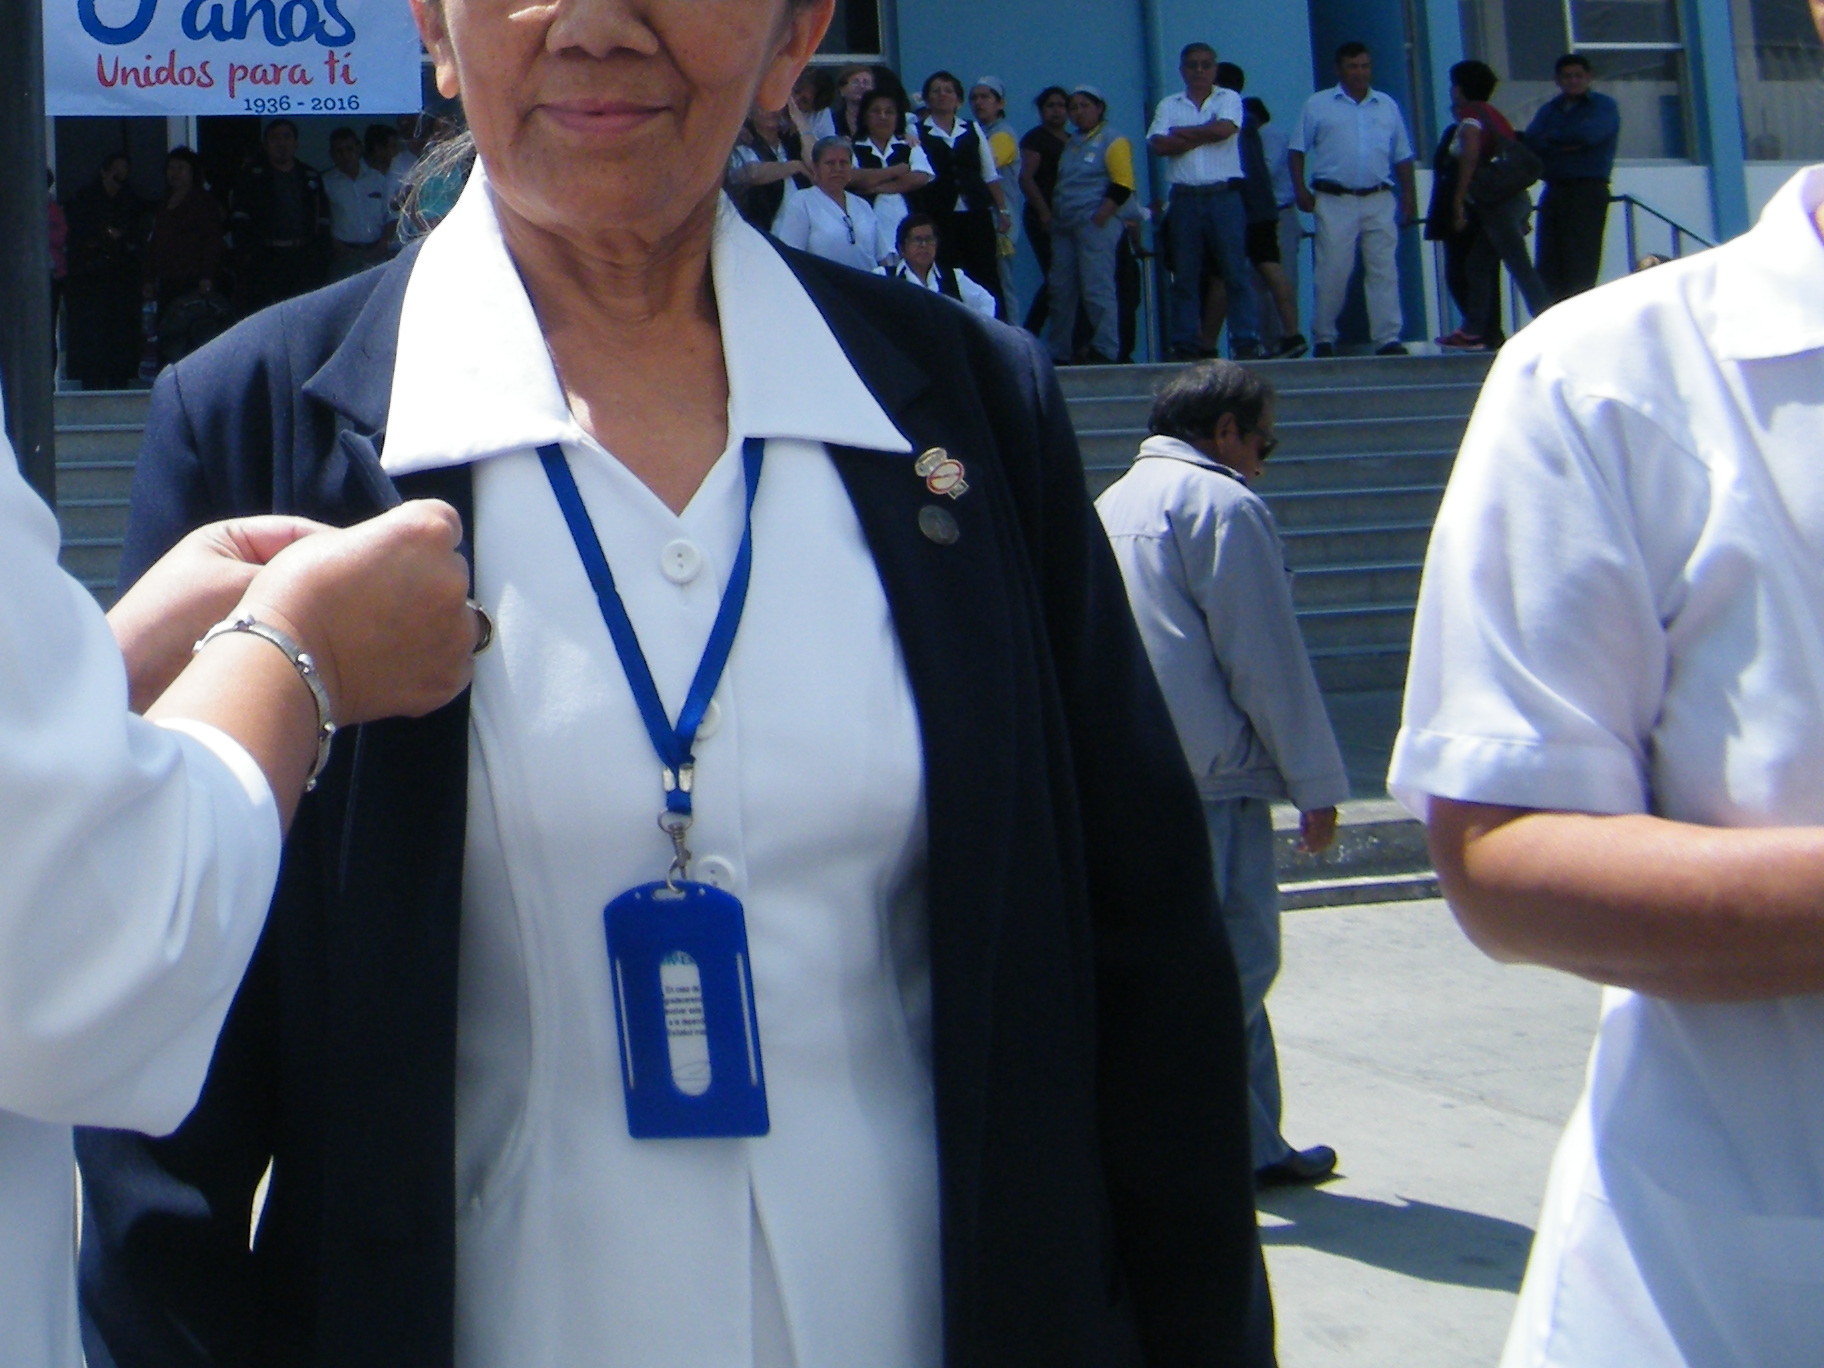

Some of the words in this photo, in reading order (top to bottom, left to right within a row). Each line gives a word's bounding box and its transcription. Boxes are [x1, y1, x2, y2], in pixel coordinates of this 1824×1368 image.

[97, 49, 214, 88] Unidos
[228, 62, 313, 99] para
[244, 95, 291, 113] 1936
[311, 95, 360, 111] 2016
